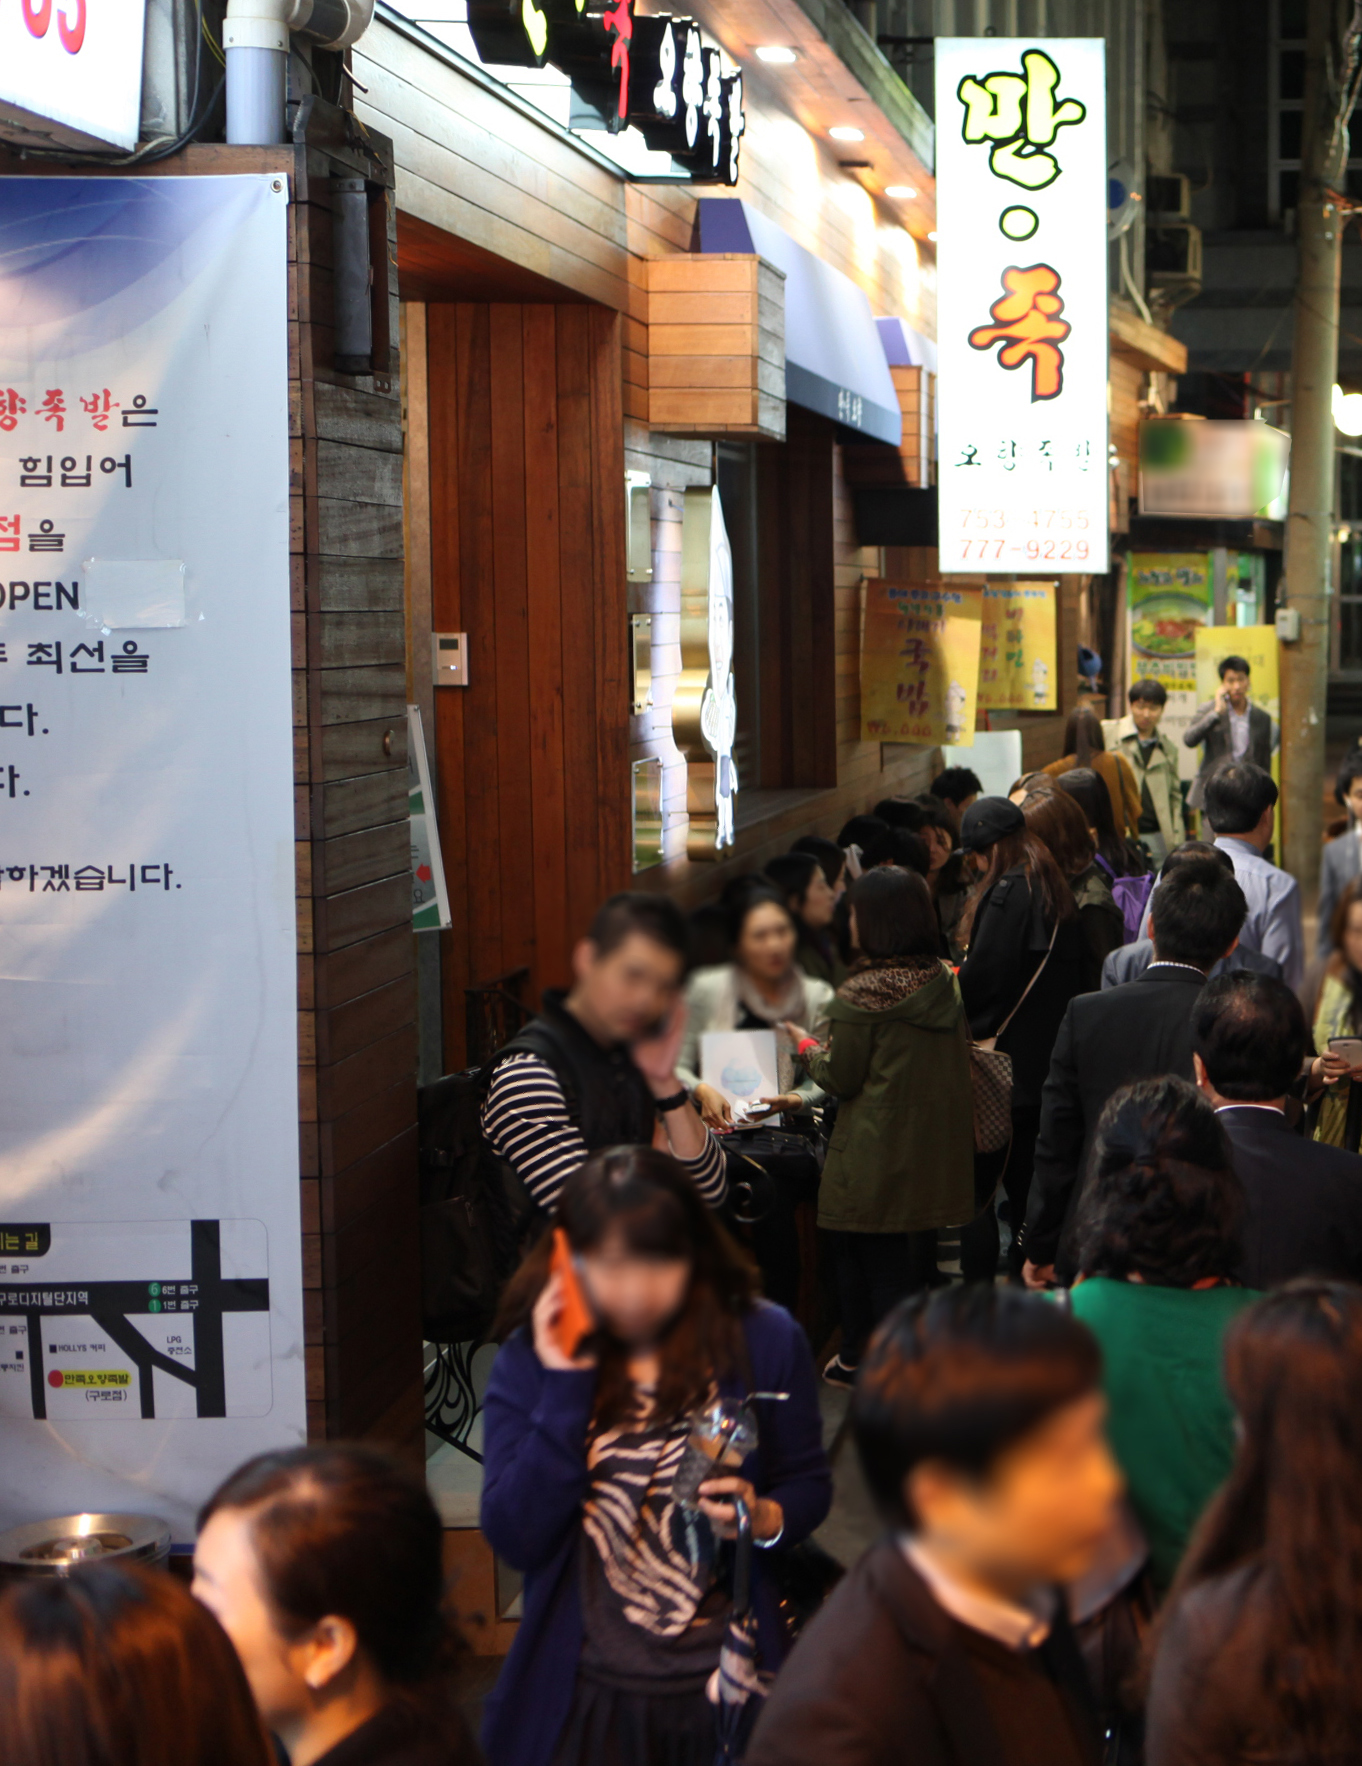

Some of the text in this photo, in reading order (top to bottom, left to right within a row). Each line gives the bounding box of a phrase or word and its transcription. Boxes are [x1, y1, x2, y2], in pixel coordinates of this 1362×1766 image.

[19, 454, 132, 488] 힘입어
[0, 514, 66, 552] 점을
[960, 539, 1089, 560] 777-9229
[26, 640, 150, 675] 최선을
[0, 863, 182, 892] 하겠습니다.
[25, 1232, 39, 1251] 길
[58, 1344, 87, 1352] HOLLYS
[166, 1335, 182, 1344] LPG
[64, 1373, 129, 1385] 만족오향족발
[85, 1389, 128, 1402] (구로점)
